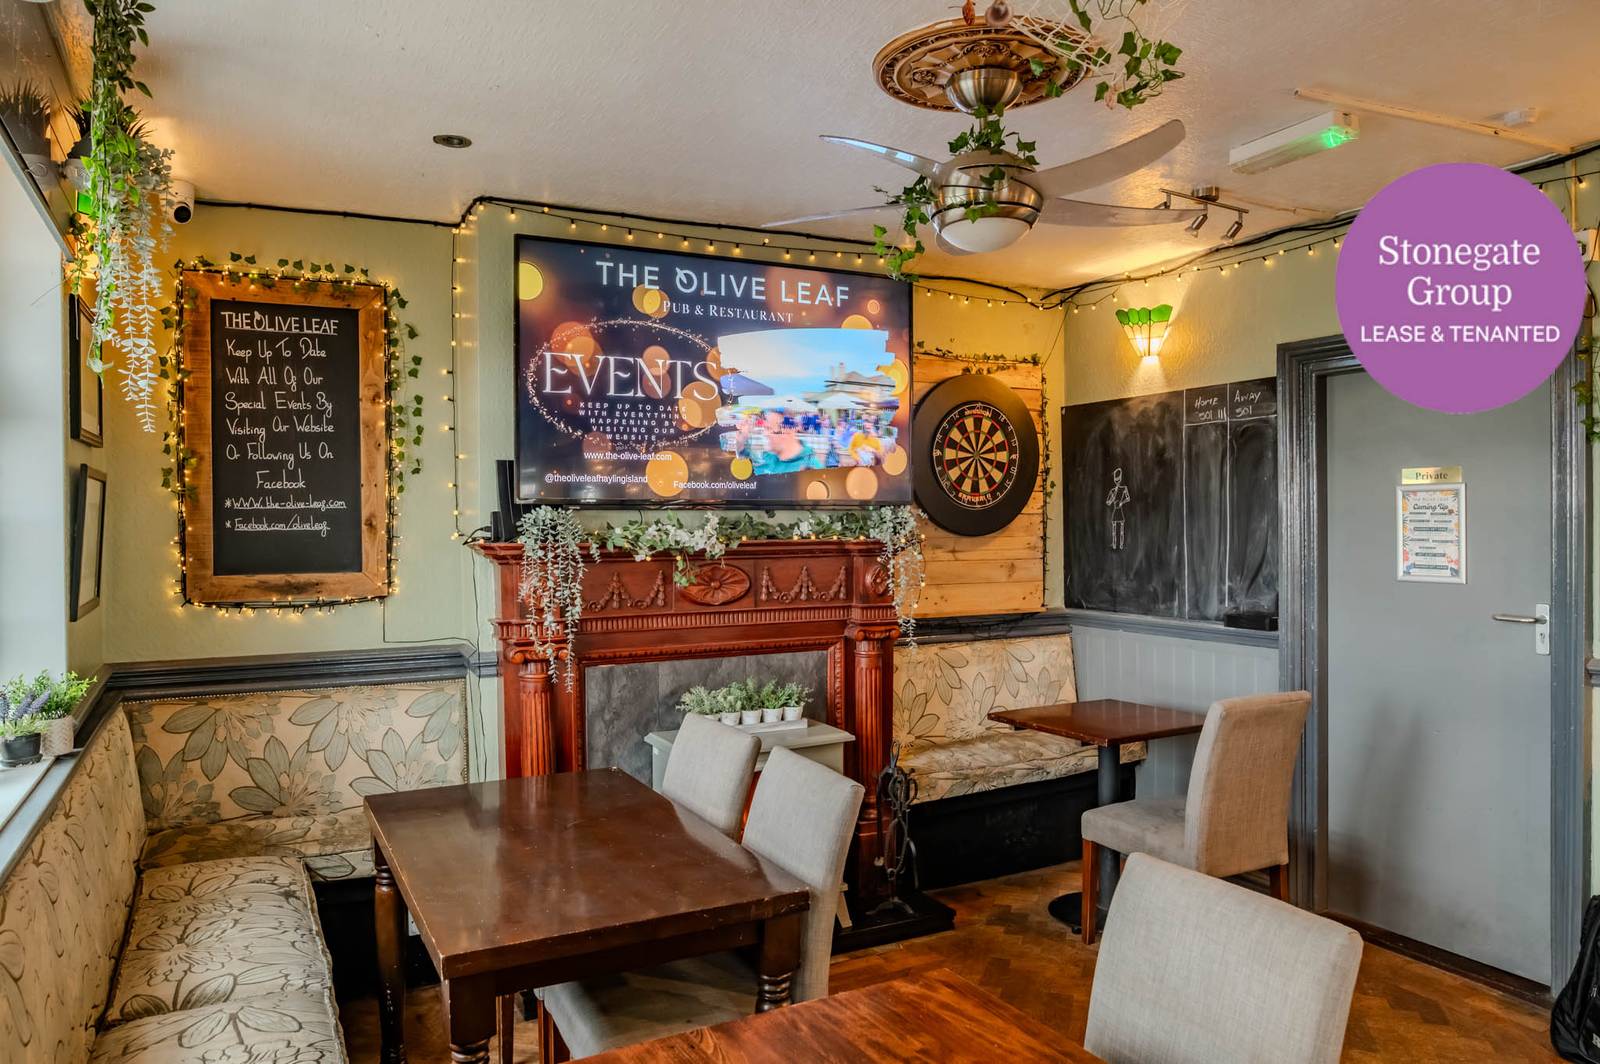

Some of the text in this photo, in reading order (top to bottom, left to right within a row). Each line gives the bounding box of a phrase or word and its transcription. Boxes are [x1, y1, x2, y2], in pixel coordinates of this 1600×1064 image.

[596, 261, 849, 307] THE OLIVE LEAF
[694, 304, 704, 316] &
[221, 310, 339, 335] THE OLIVE LEAF
[226, 337, 327, 364] Keep Up To Date
[226, 367, 250, 385] With
[257, 367, 277, 385] All
[303, 366, 323, 385] Our
[542, 351, 719, 401] EVENTS
[225, 391, 333, 418] Special Events By
[659, 405, 687, 413] DATE
[590, 418, 656, 427] HAPPENING
[615, 411, 687, 420] EVERYTHING
[226, 414, 335, 443] Visiting Our Website
[606, 433, 657, 441] WEBSITE
[226, 441, 334, 470] Or Following Us On
[583, 451, 672, 462] www.the-olive-leaf.com
[256, 468, 307, 489] Facebook
[544, 473, 648, 485] @theoliveleafhaylingisland
[1415, 471, 1449, 480] Private
[673, 480, 757, 490] Facebook.com/oliveleaf
